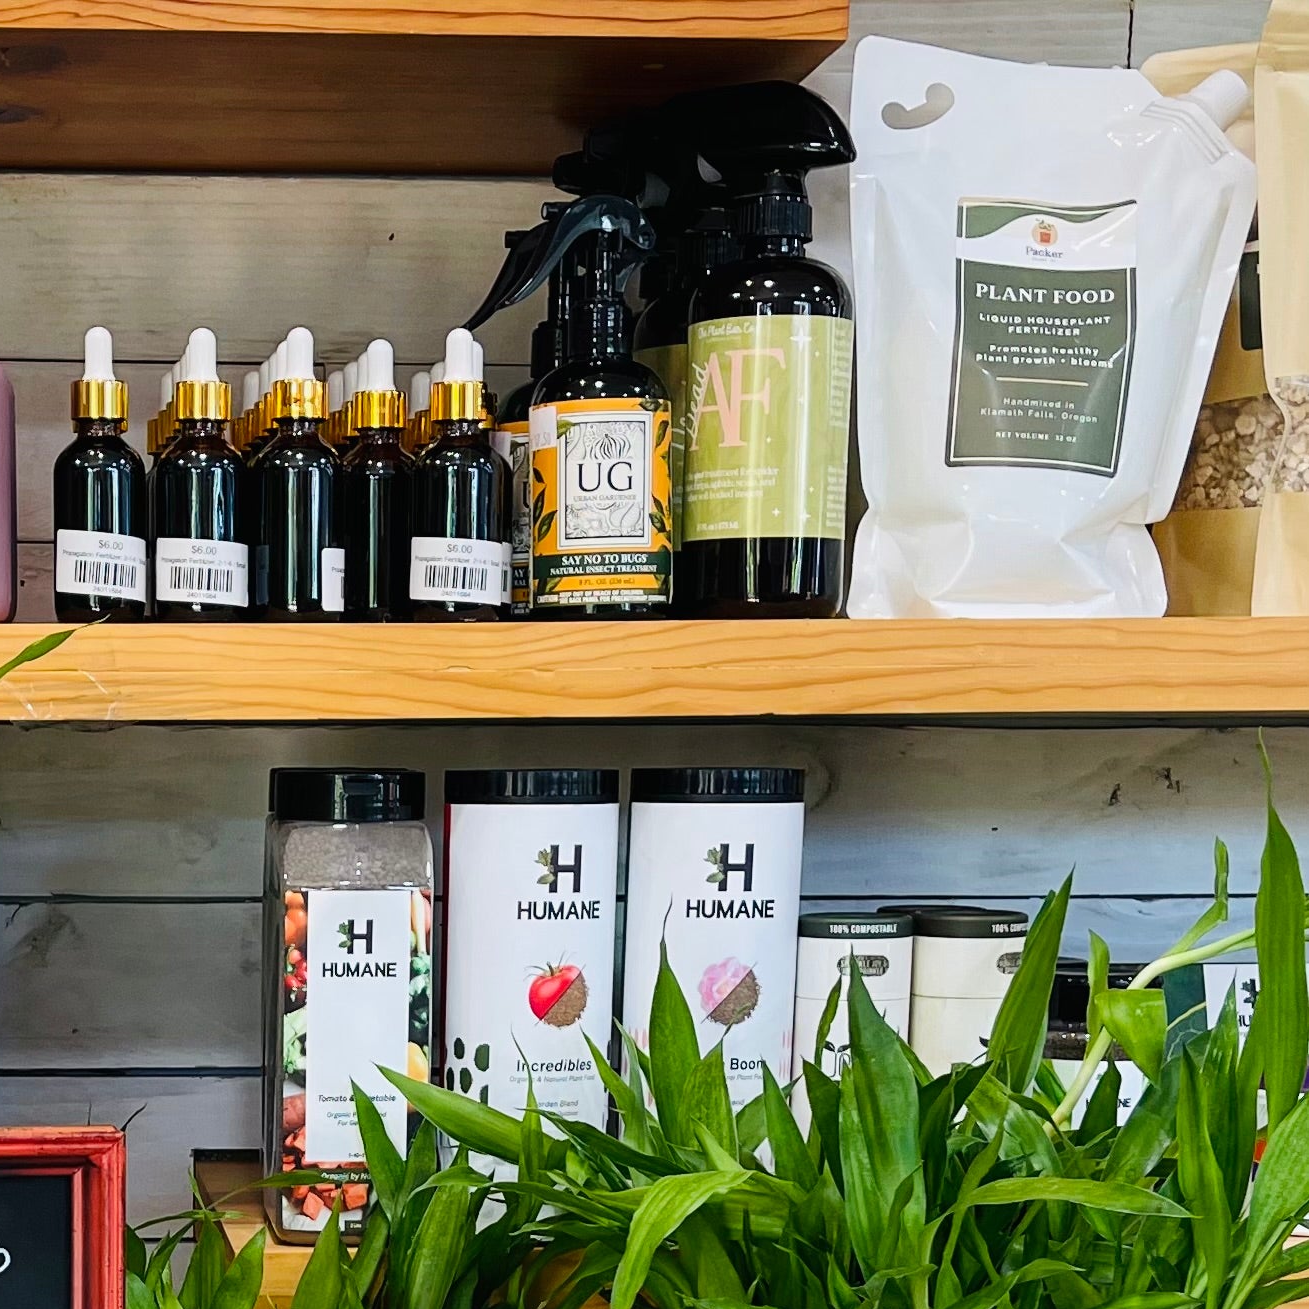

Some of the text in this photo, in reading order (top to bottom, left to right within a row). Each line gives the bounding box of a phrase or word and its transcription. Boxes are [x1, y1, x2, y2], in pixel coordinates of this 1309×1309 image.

[1026, 246, 1063, 258] Packer
[976, 282, 1115, 305] PLANT FOOD
[979, 313, 1111, 326] LIQUID HOUSEPLANT
[1008, 326, 1081, 336] FERTILIZER
[989, 344, 1099, 357] Promotes healthy
[975, 354, 1114, 368] plant growth blooms
[689, 347, 787, 451] AF
[1003, 398, 1075, 410] Handmixed in
[980, 408, 1024, 418] Klamath
[1061, 412, 1098, 424] Oregon
[1015, 432, 1050, 441] VOLUME
[577, 461, 634, 492] UG
[98, 539, 124, 550] $6.00
[191, 544, 217, 555] $6.00
[446, 543, 473, 554] $6.00
[561, 553, 649, 566] SAY NO TO BUGS
[549, 564, 657, 576] NATURAL INSECT TREATMENT
[548, 844, 583, 894] H
[718, 843, 755, 892] H
[517, 900, 601, 920] HUMANE
[686, 898, 775, 919] HUMANE
[829, 924, 897, 934] 100% COMPOSTABLE
[991, 924, 1009, 934] 100%
[347, 919, 374, 954] H
[322, 962, 398, 978] HUMANE
[516, 1058, 593, 1073] Incredibles
[317, 1094, 348, 1102] Tomato
[326, 1112, 352, 1120] Organic
[350, 1172, 360, 1180] by
